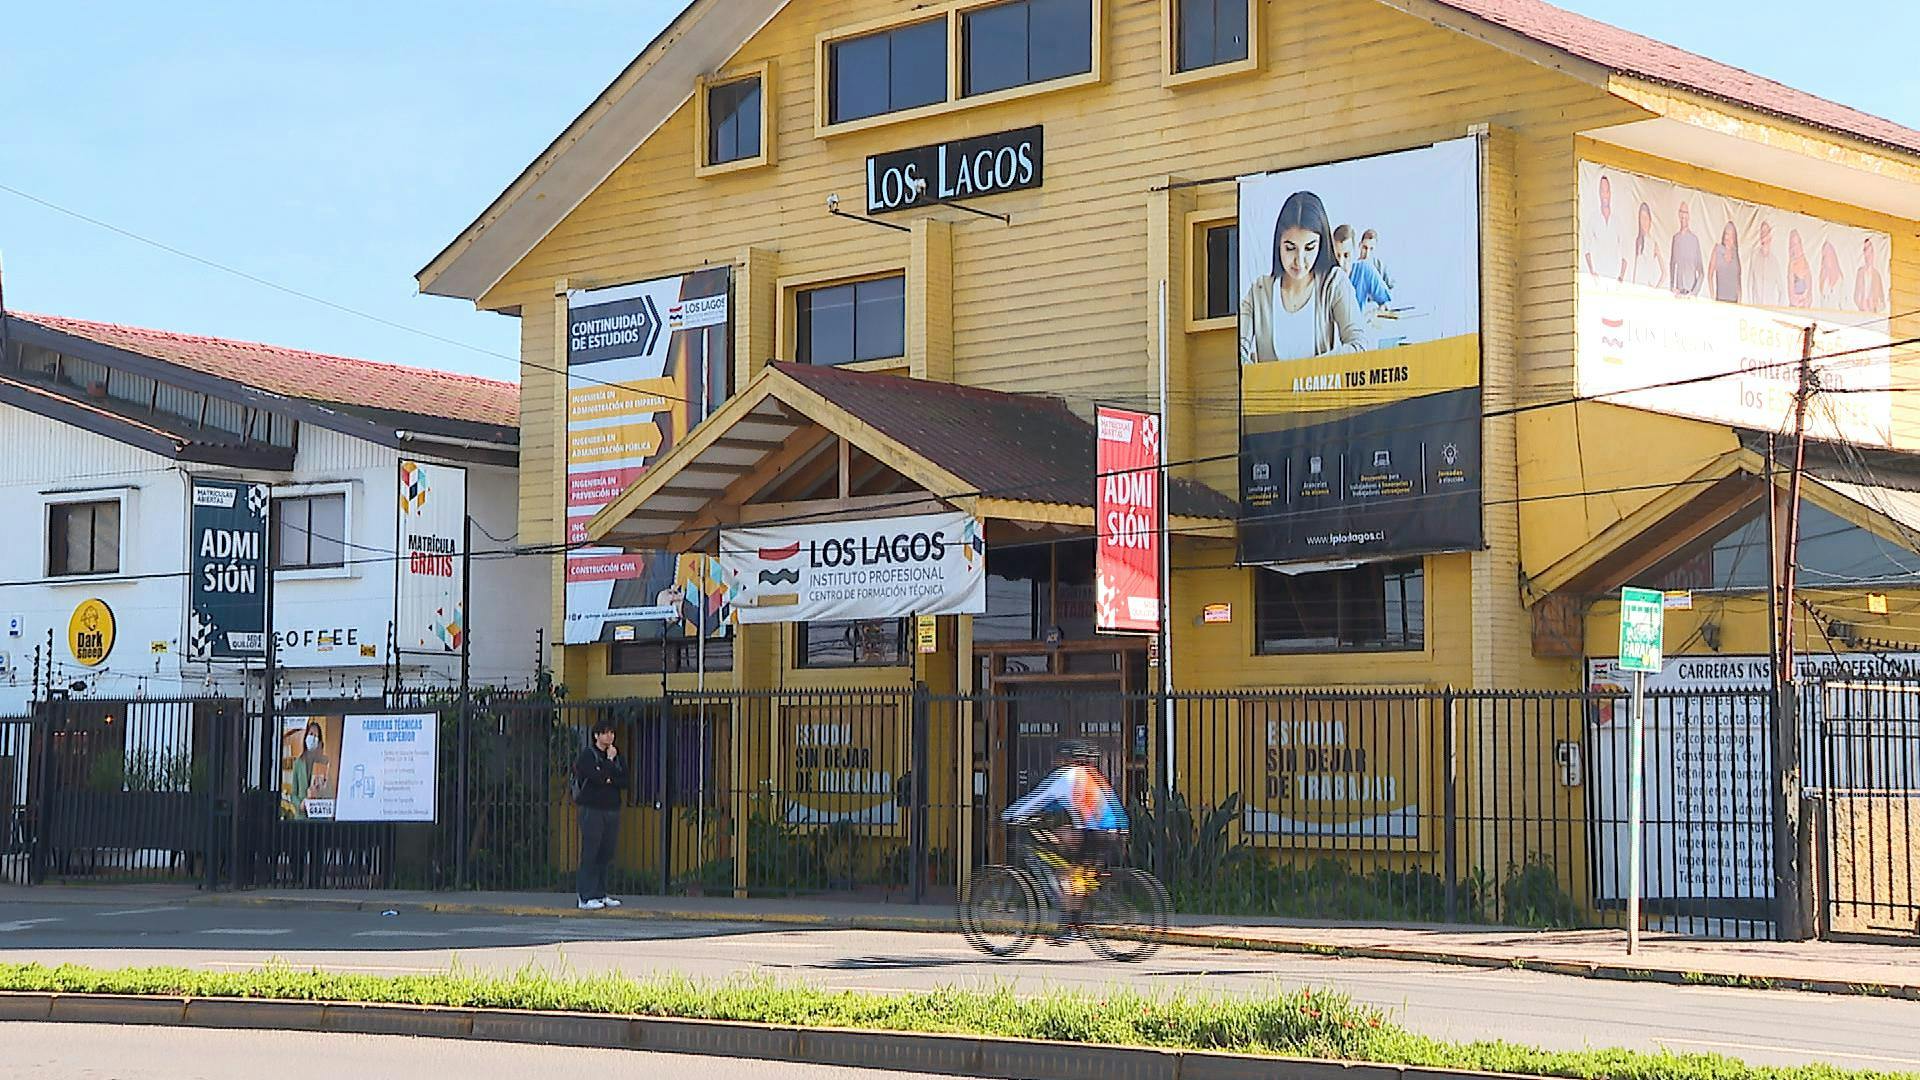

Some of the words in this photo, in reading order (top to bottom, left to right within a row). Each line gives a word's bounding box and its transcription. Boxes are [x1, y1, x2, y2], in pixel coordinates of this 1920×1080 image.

[867, 158, 918, 209] LOS
[938, 143, 1033, 199] LAGOS
[685, 303, 700, 314] LOS
[572, 313, 645, 336] CONTINUIDAD
[572, 337, 587, 351] DE
[589, 329, 639, 348] ESTUDIOS
[1293, 376, 1342, 392] ALCANZA
[1345, 371, 1366, 387] TUS
[1369, 366, 1409, 384] METAS
[1740, 381, 1763, 410] los
[1104, 469, 1153, 508] ADMI
[1107, 507, 1150, 550] SIÓN
[200, 528, 259, 560] ADMI
[408, 534, 456, 555] MATRÍCULA
[810, 538, 856, 568] LOS
[862, 531, 945, 565] LAGOS
[410, 551, 453, 577] GRATIS
[571, 562, 619, 575] CONSTRUCCIÓN
[620, 561, 636, 571] CIVIL
[203, 559, 256, 593] SIÓN
[810, 570, 866, 588] INSTITUTO
[869, 566, 945, 583] PROFESIONAL
[809, 589, 843, 601] CENTRO
[844, 590, 856, 600] DE
[857, 586, 907, 599] FORMACIÓN
[908, 583, 944, 597] TÉCNICA
[77, 631, 103, 647] Dark
[272, 629, 358, 648] COFFEE
[1678, 663, 1744, 680] CARRERAS
[368, 731, 385, 743] NIVEL
[387, 731, 416, 742] SUPERIOR
[1267, 748, 1297, 772] SIN
[1267, 775, 1290, 800] DE
